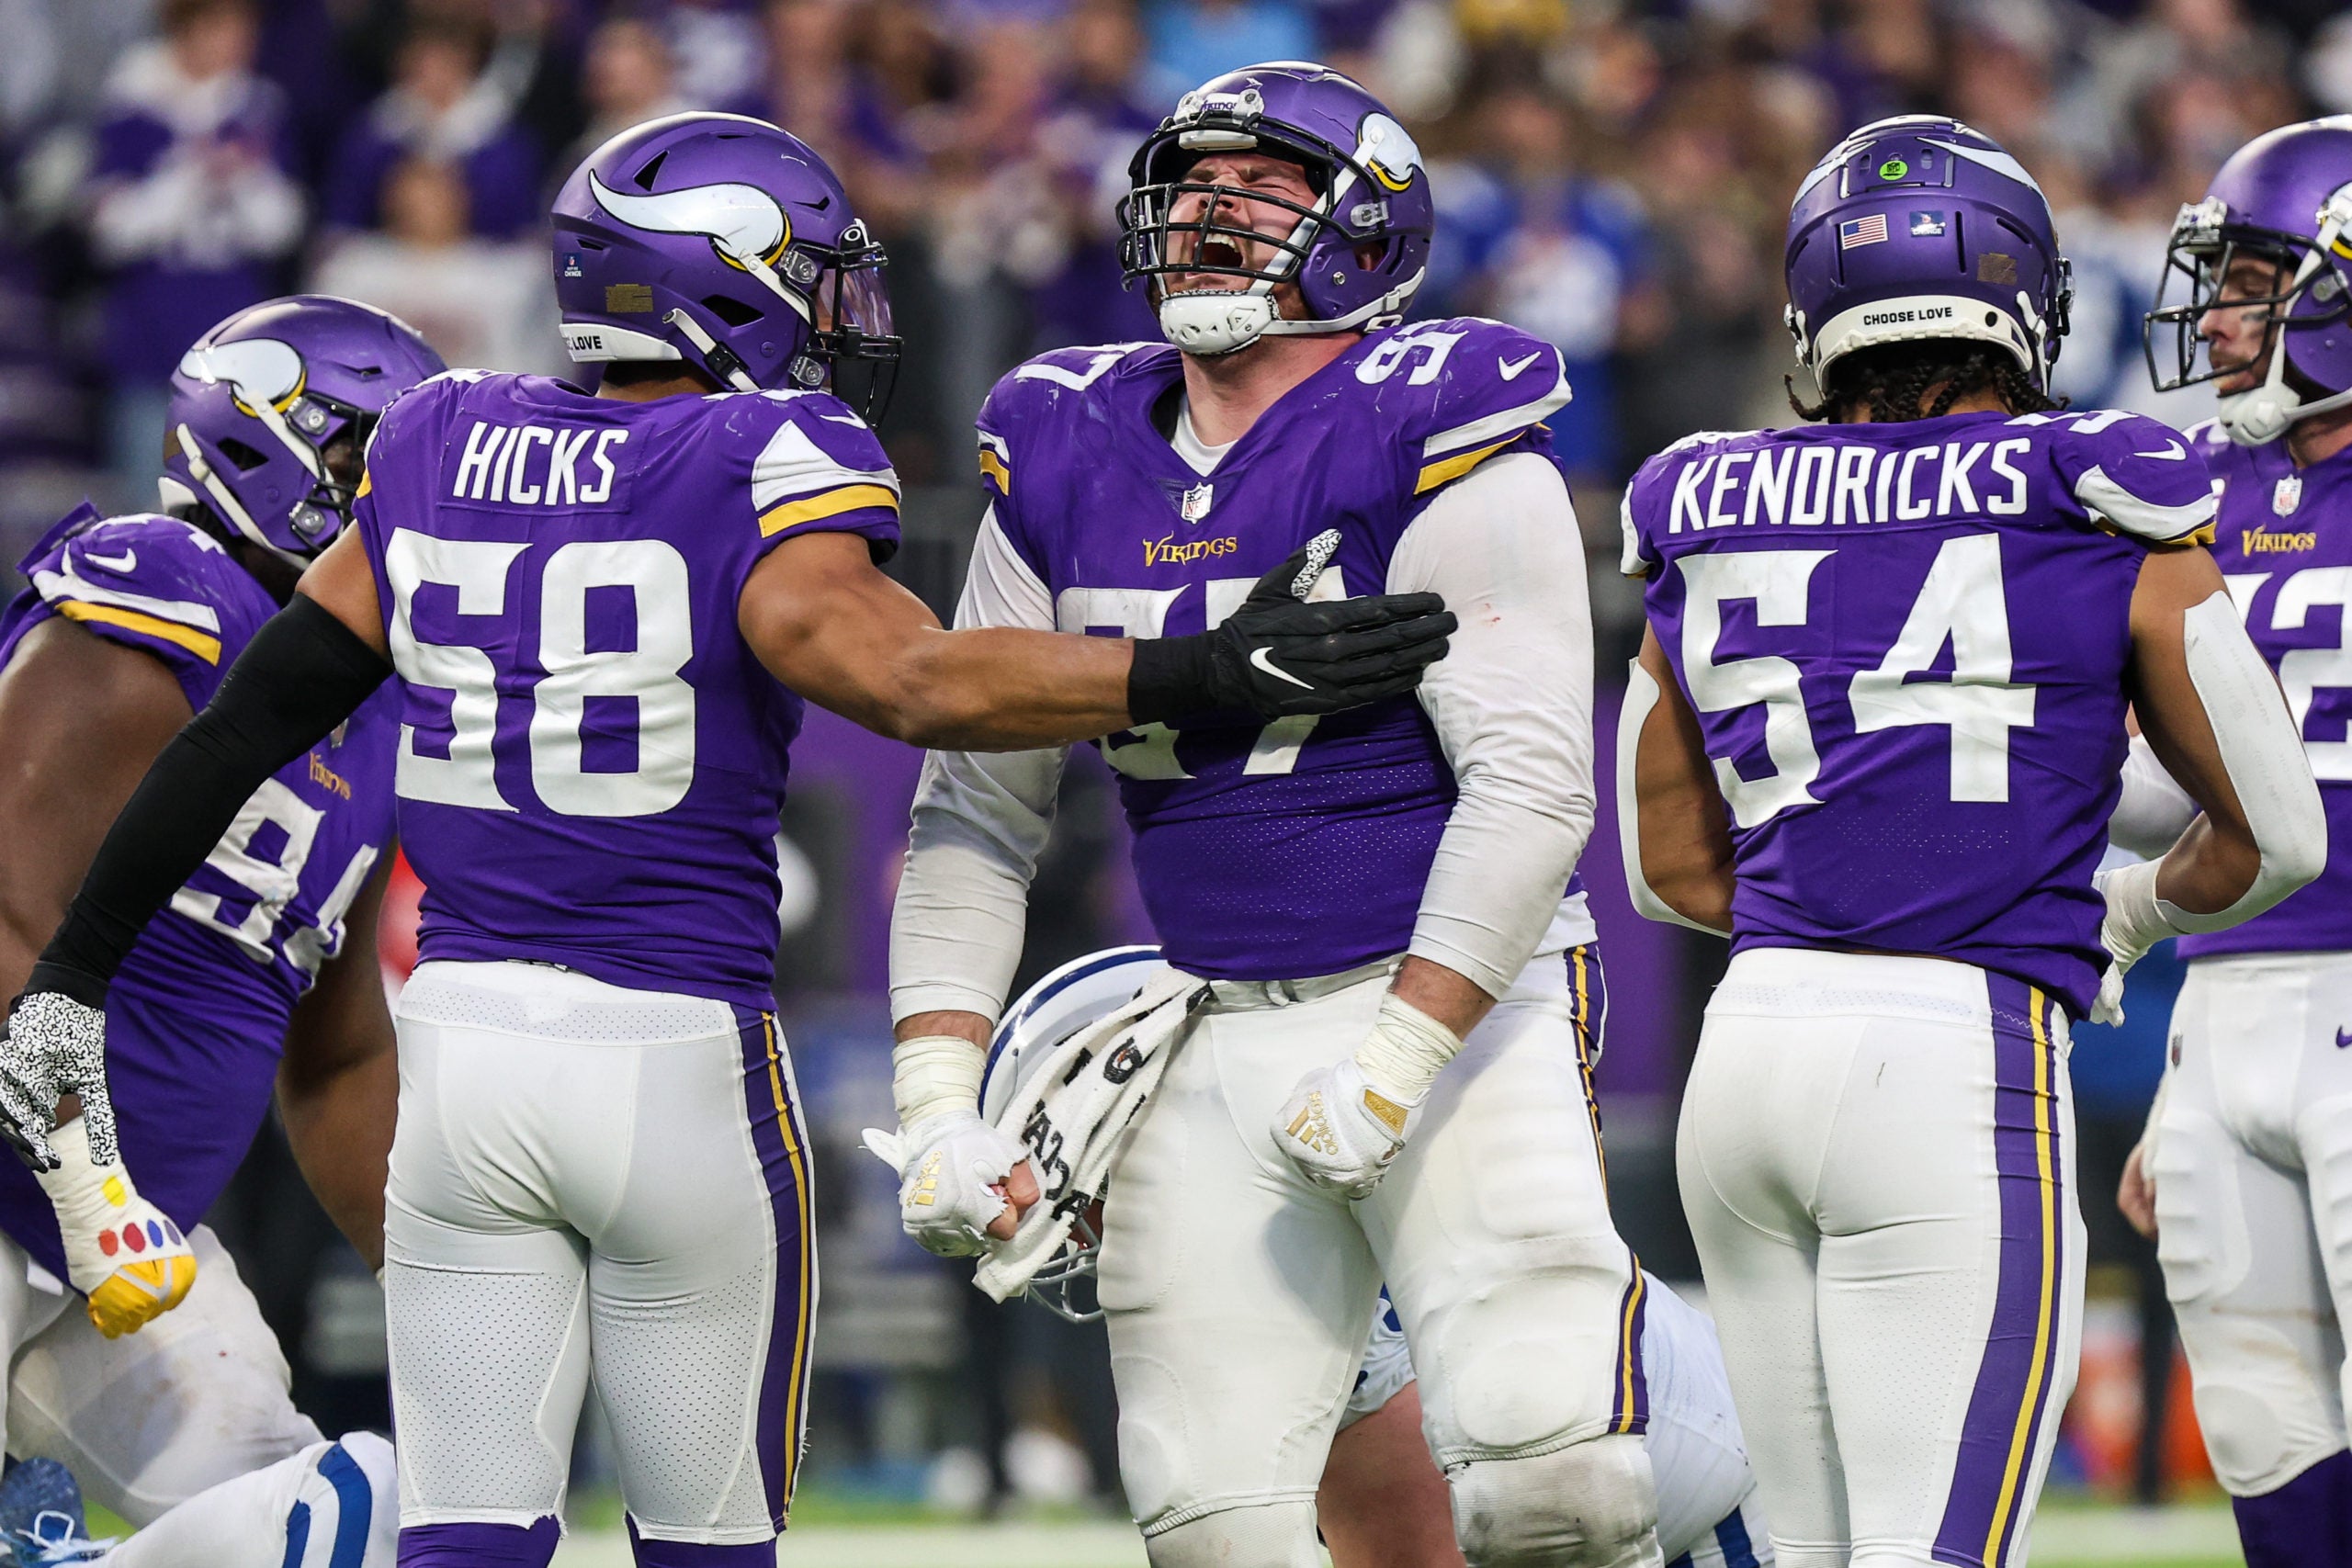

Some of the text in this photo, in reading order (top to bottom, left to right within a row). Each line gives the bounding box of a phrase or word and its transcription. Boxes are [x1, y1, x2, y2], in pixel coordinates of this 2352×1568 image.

[571, 335, 603, 351] LOVE
[1863, 307, 1952, 325] CHOOSE LOVE
[452, 420, 629, 506] HICKS
[1668, 437, 2030, 534] KENDRICKS
[385, 526, 695, 817] 58
[1674, 533, 2038, 829] 54
